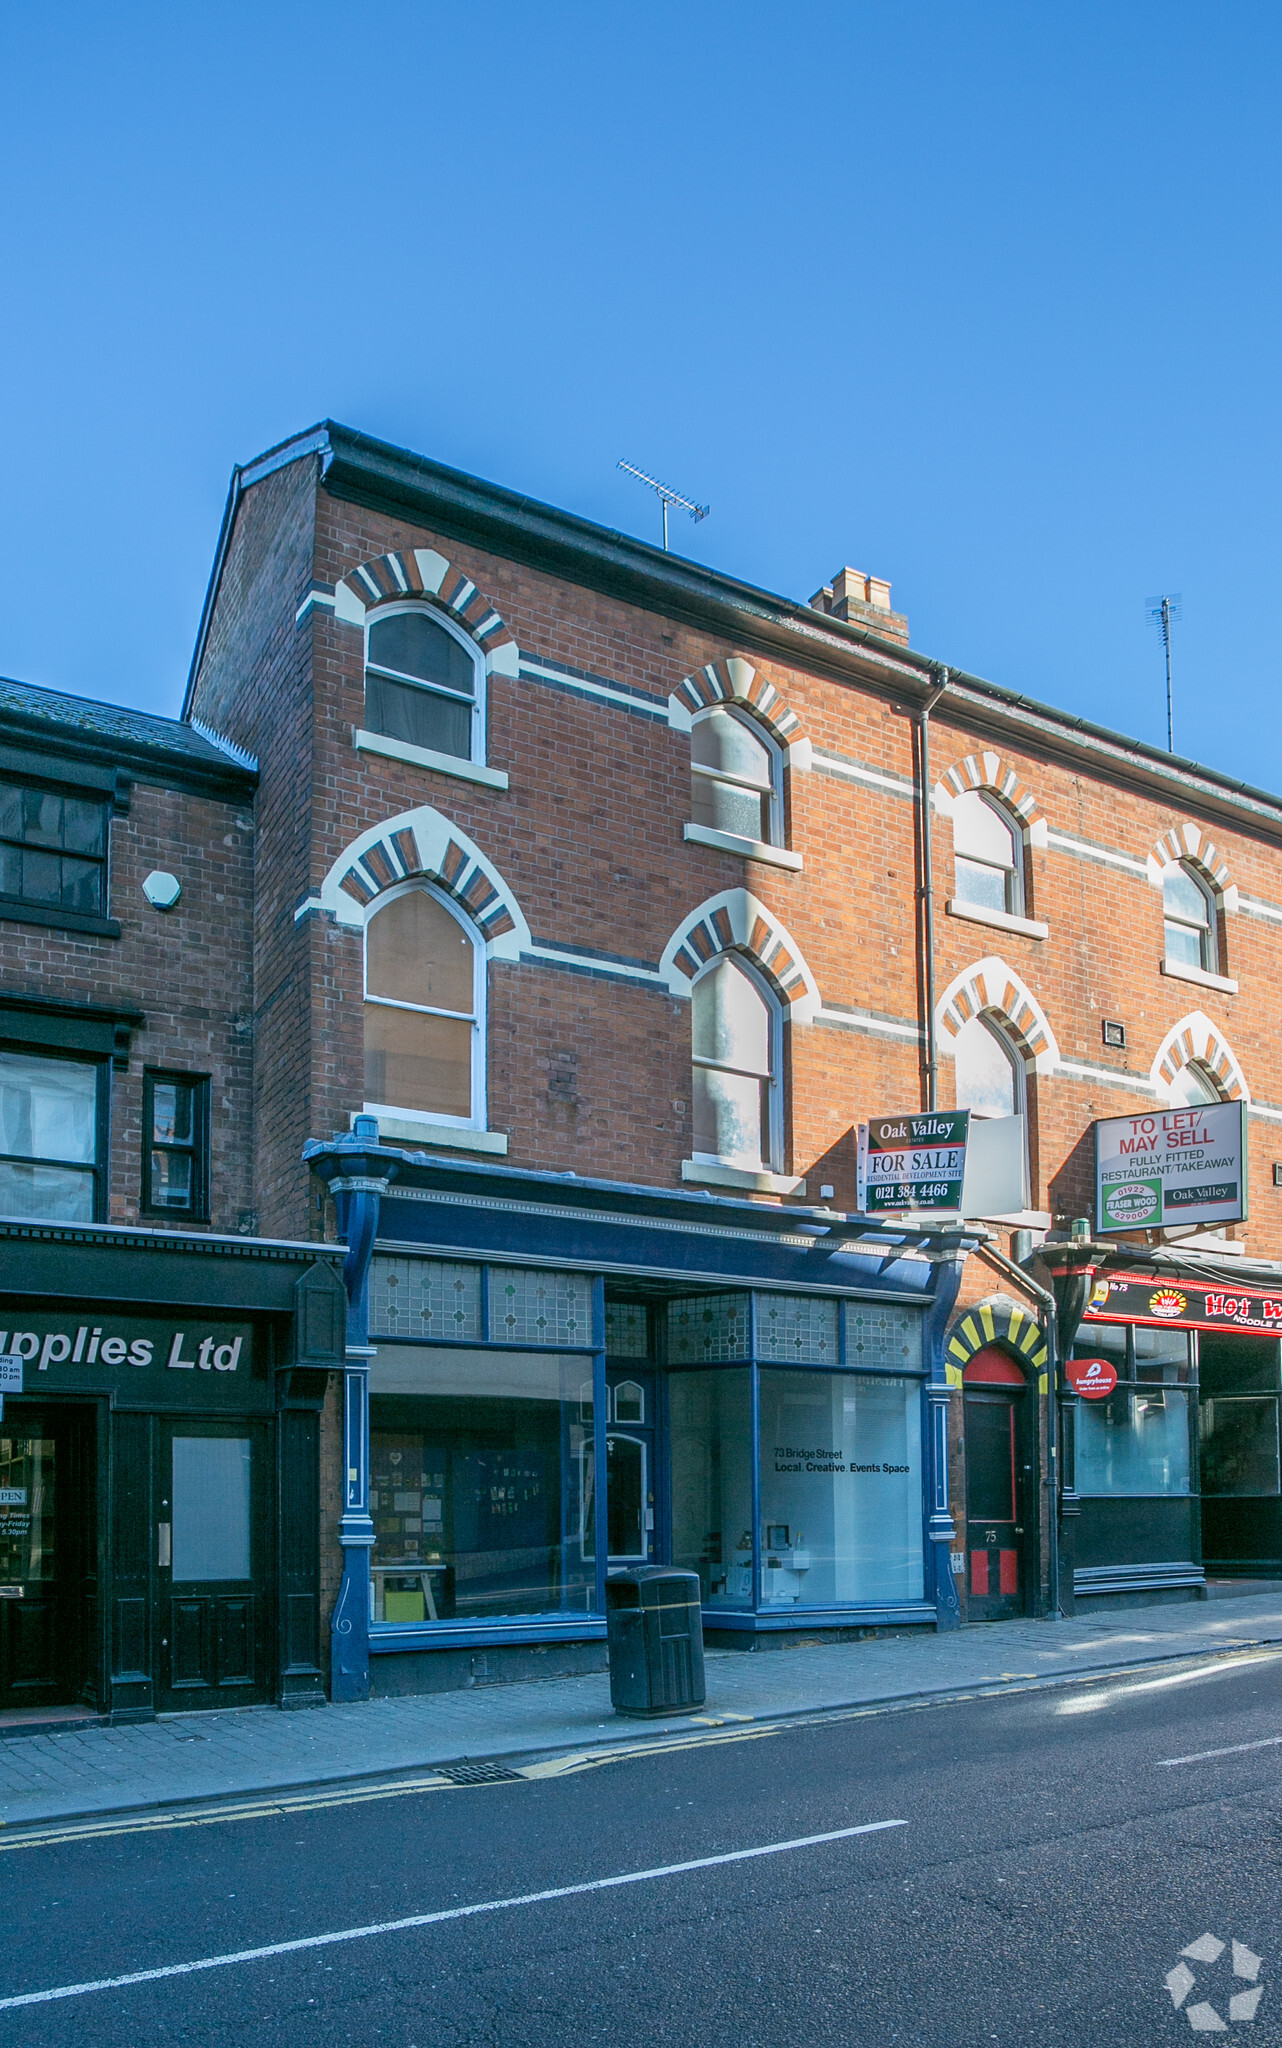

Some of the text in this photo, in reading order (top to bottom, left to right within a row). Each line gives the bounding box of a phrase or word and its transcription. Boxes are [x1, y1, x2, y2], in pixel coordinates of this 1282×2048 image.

[880, 1119, 955, 1139] Oak Valley
[1129, 1110, 1204, 1136] TO LET/
[1119, 1128, 1215, 1155] MAY SELL
[871, 1150, 959, 1174] FOR SALE
[1129, 1149, 1205, 1167] FULLY FITTED
[866, 1170, 963, 1182] RESIDENTIAL DEVELOPMENT SITE
[1101, 1156, 1235, 1182] RESTAURANT/TAKEAWAY
[875, 1183, 949, 1200] 0121 384 4466
[1118, 1186, 1145, 1196] 01922
[1172, 1186, 1228, 1201] Oak Valley
[1106, 1196, 1158, 1210] FRASER WOOD
[1114, 1208, 1149, 1220] 629000
[1109, 1283, 1129, 1292] No 75
[1204, 1294, 1252, 1317] Hot
[1232, 1314, 1274, 1328] NOODLE
[168, 1332, 244, 1371] Ltd
[774, 1448, 843, 1460] 73 Bridge Street
[850, 1462, 881, 1473] Events
[882, 1463, 910, 1475] Space
[1, 1492, 22, 1500] PEN
[985, 1530, 997, 1543] 75
